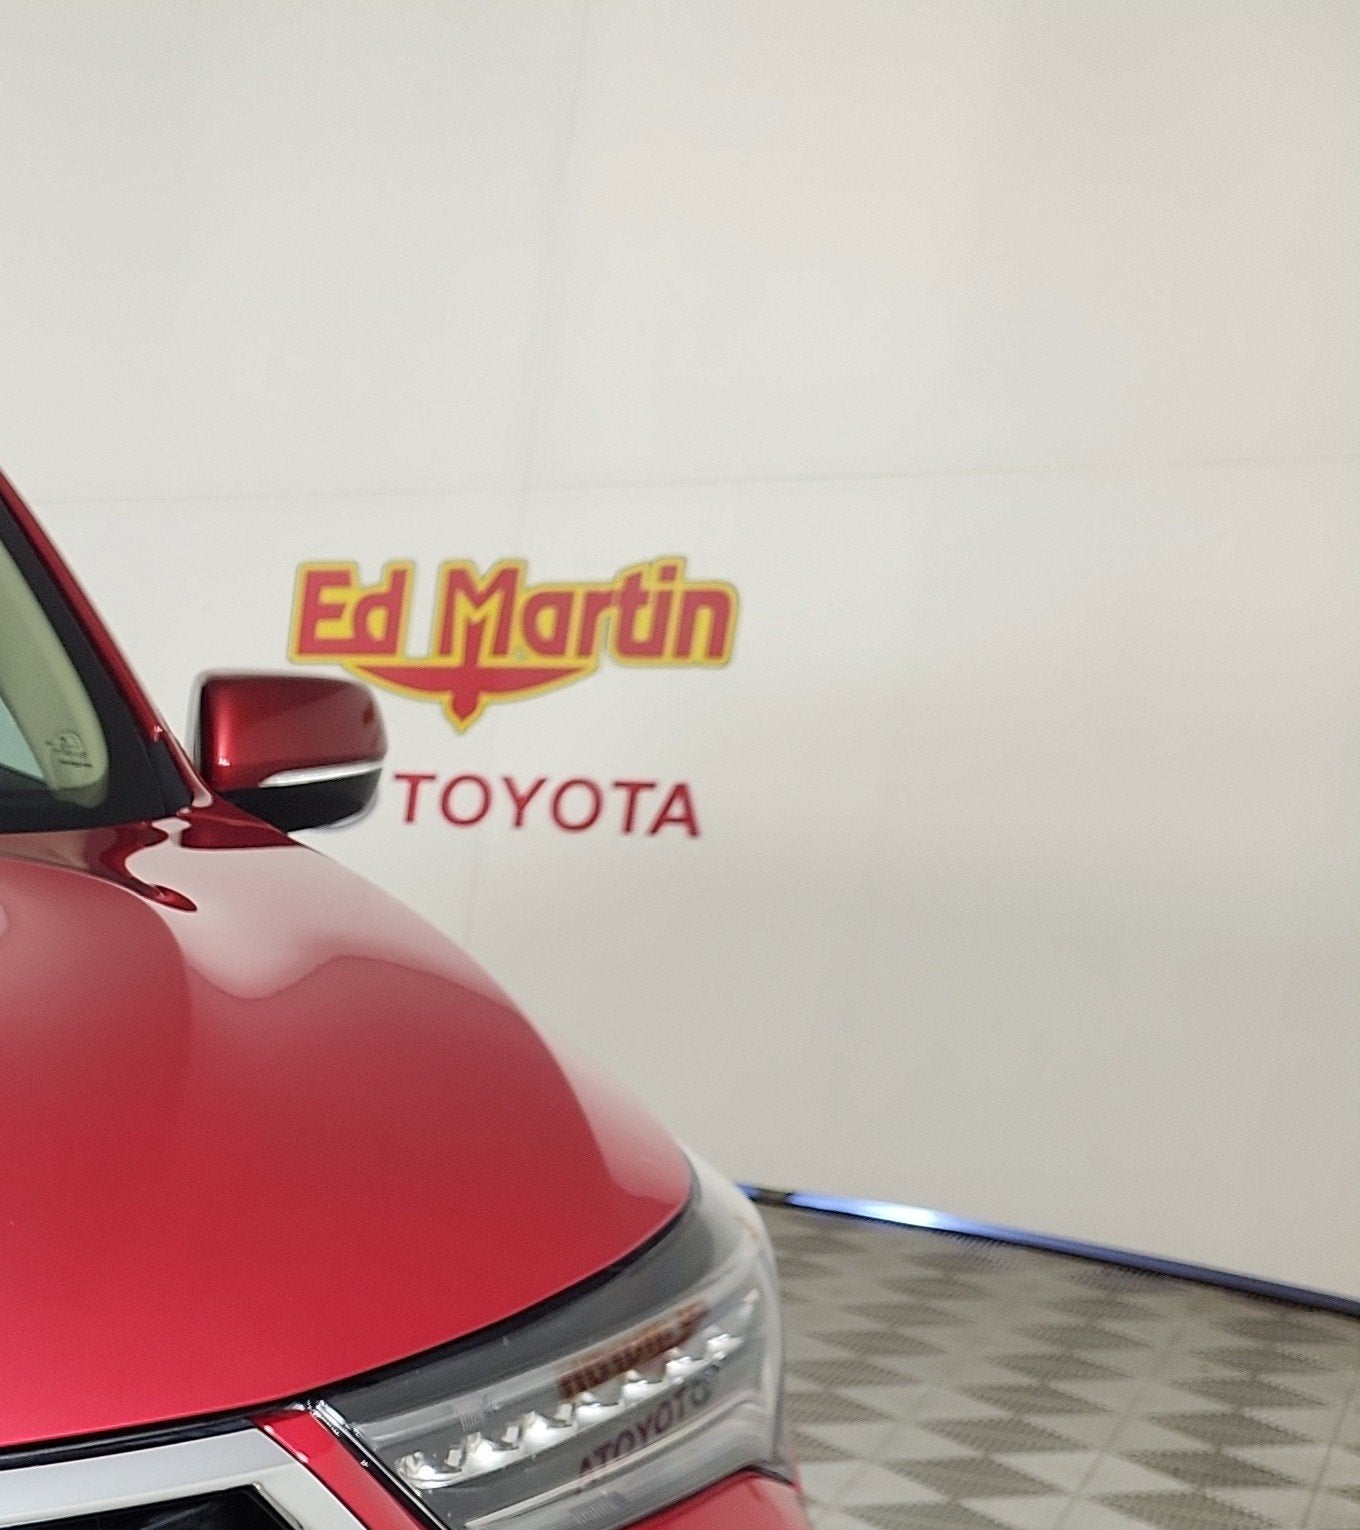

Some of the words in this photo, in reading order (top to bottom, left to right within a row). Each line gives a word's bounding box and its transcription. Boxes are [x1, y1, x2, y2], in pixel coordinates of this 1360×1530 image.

[291, 564, 412, 660] Ed
[432, 559, 736, 664] Martin
[394, 774, 701, 838] TOYOTA
